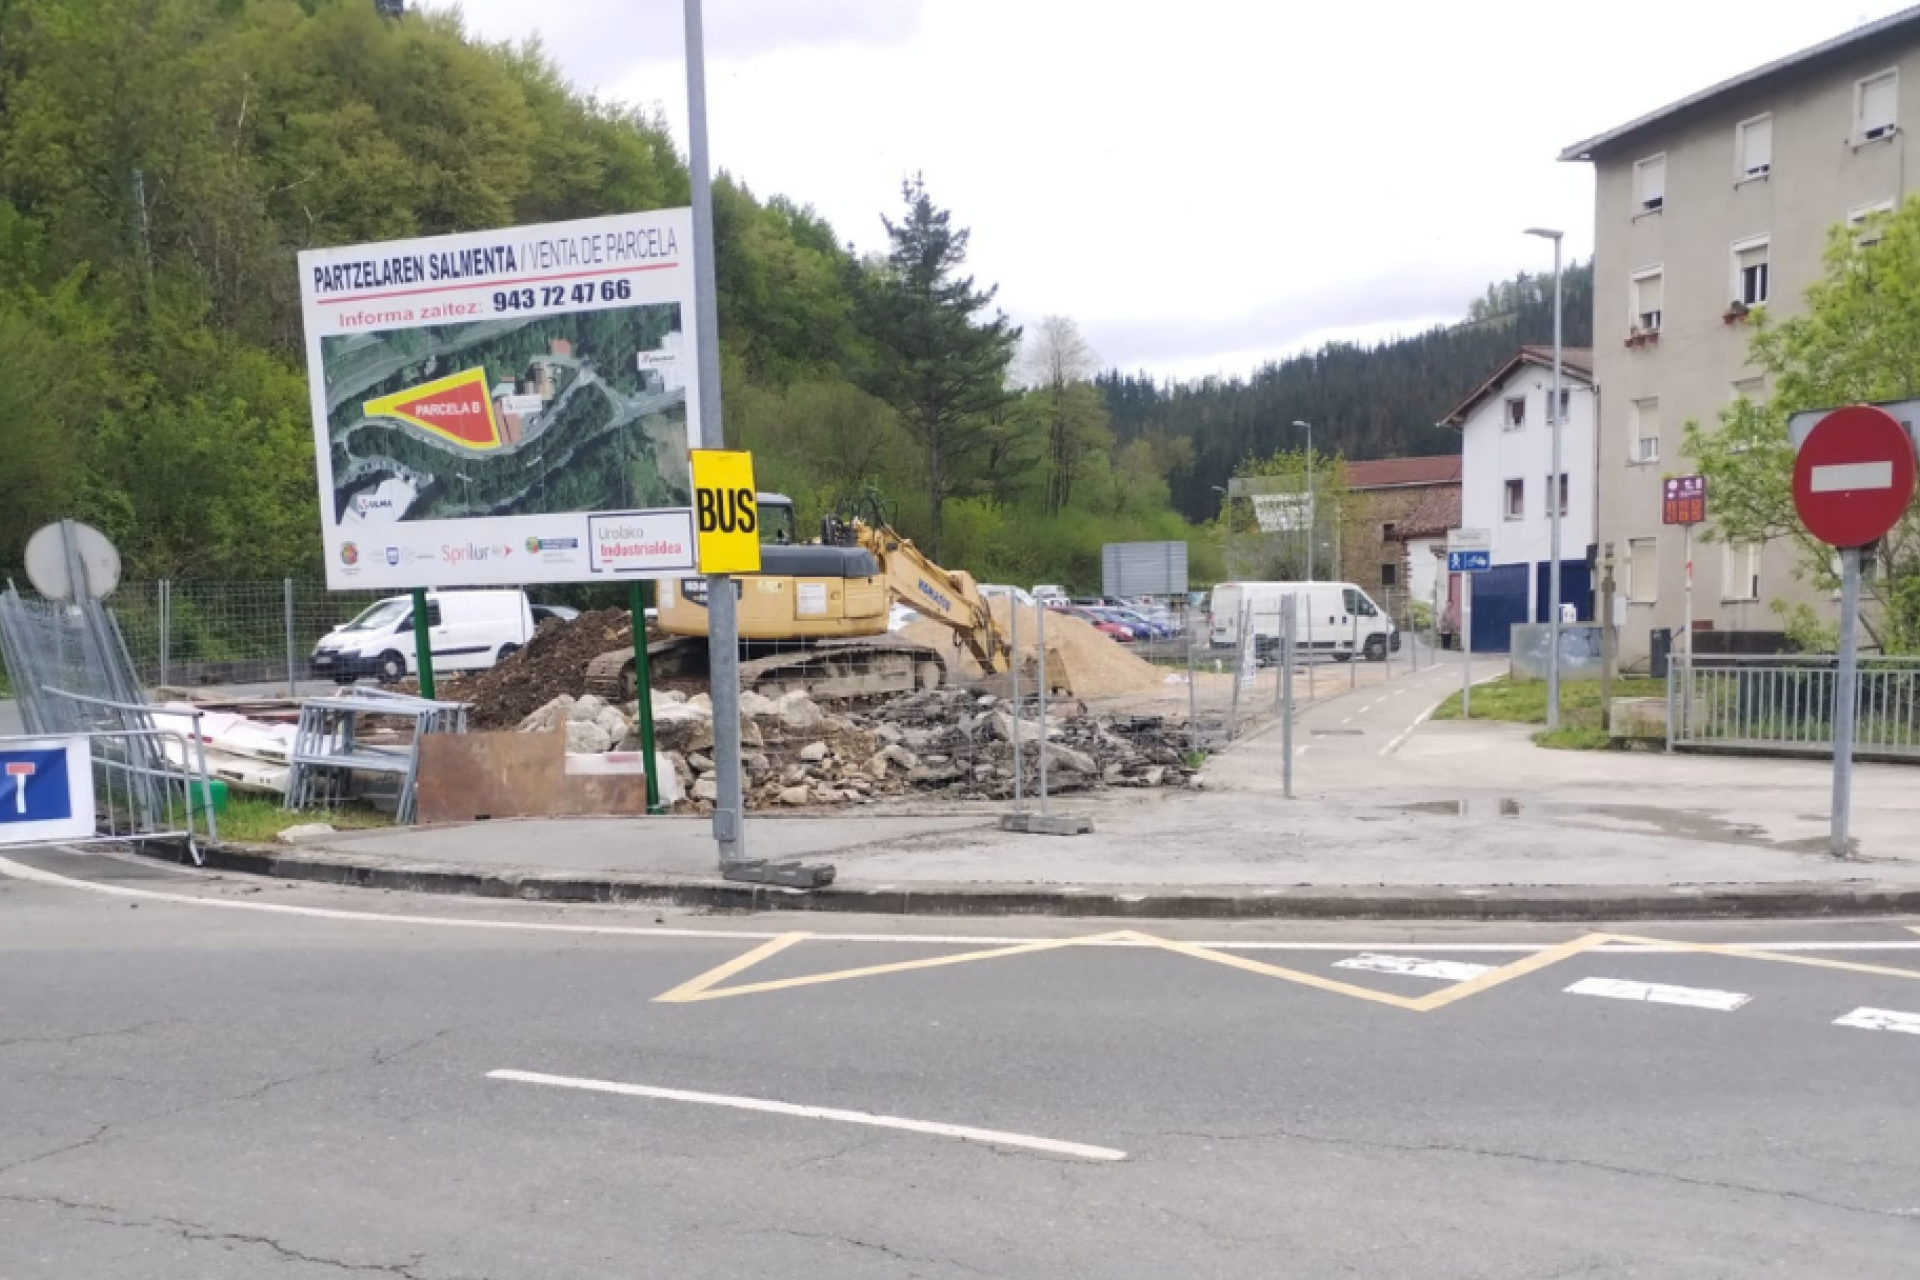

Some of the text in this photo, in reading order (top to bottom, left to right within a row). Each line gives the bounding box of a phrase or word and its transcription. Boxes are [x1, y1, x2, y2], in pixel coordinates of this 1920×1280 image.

[313, 254, 425, 293] PARTZELAREN
[429, 245, 517, 280] SALMENTA
[529, 237, 580, 270] VENTA
[582, 235, 604, 264] DE
[606, 227, 678, 262] PARCELA
[340, 308, 415, 327] Informa
[493, 287, 536, 312] 943
[540, 285, 566, 307] 72
[571, 282, 596, 304] 47
[601, 278, 632, 302] 66
[415, 401, 470, 416] PARCELA
[697, 487, 755, 533] BUS
[598, 525, 643, 540] Urolako
[441, 543, 490, 565] Sprilur
